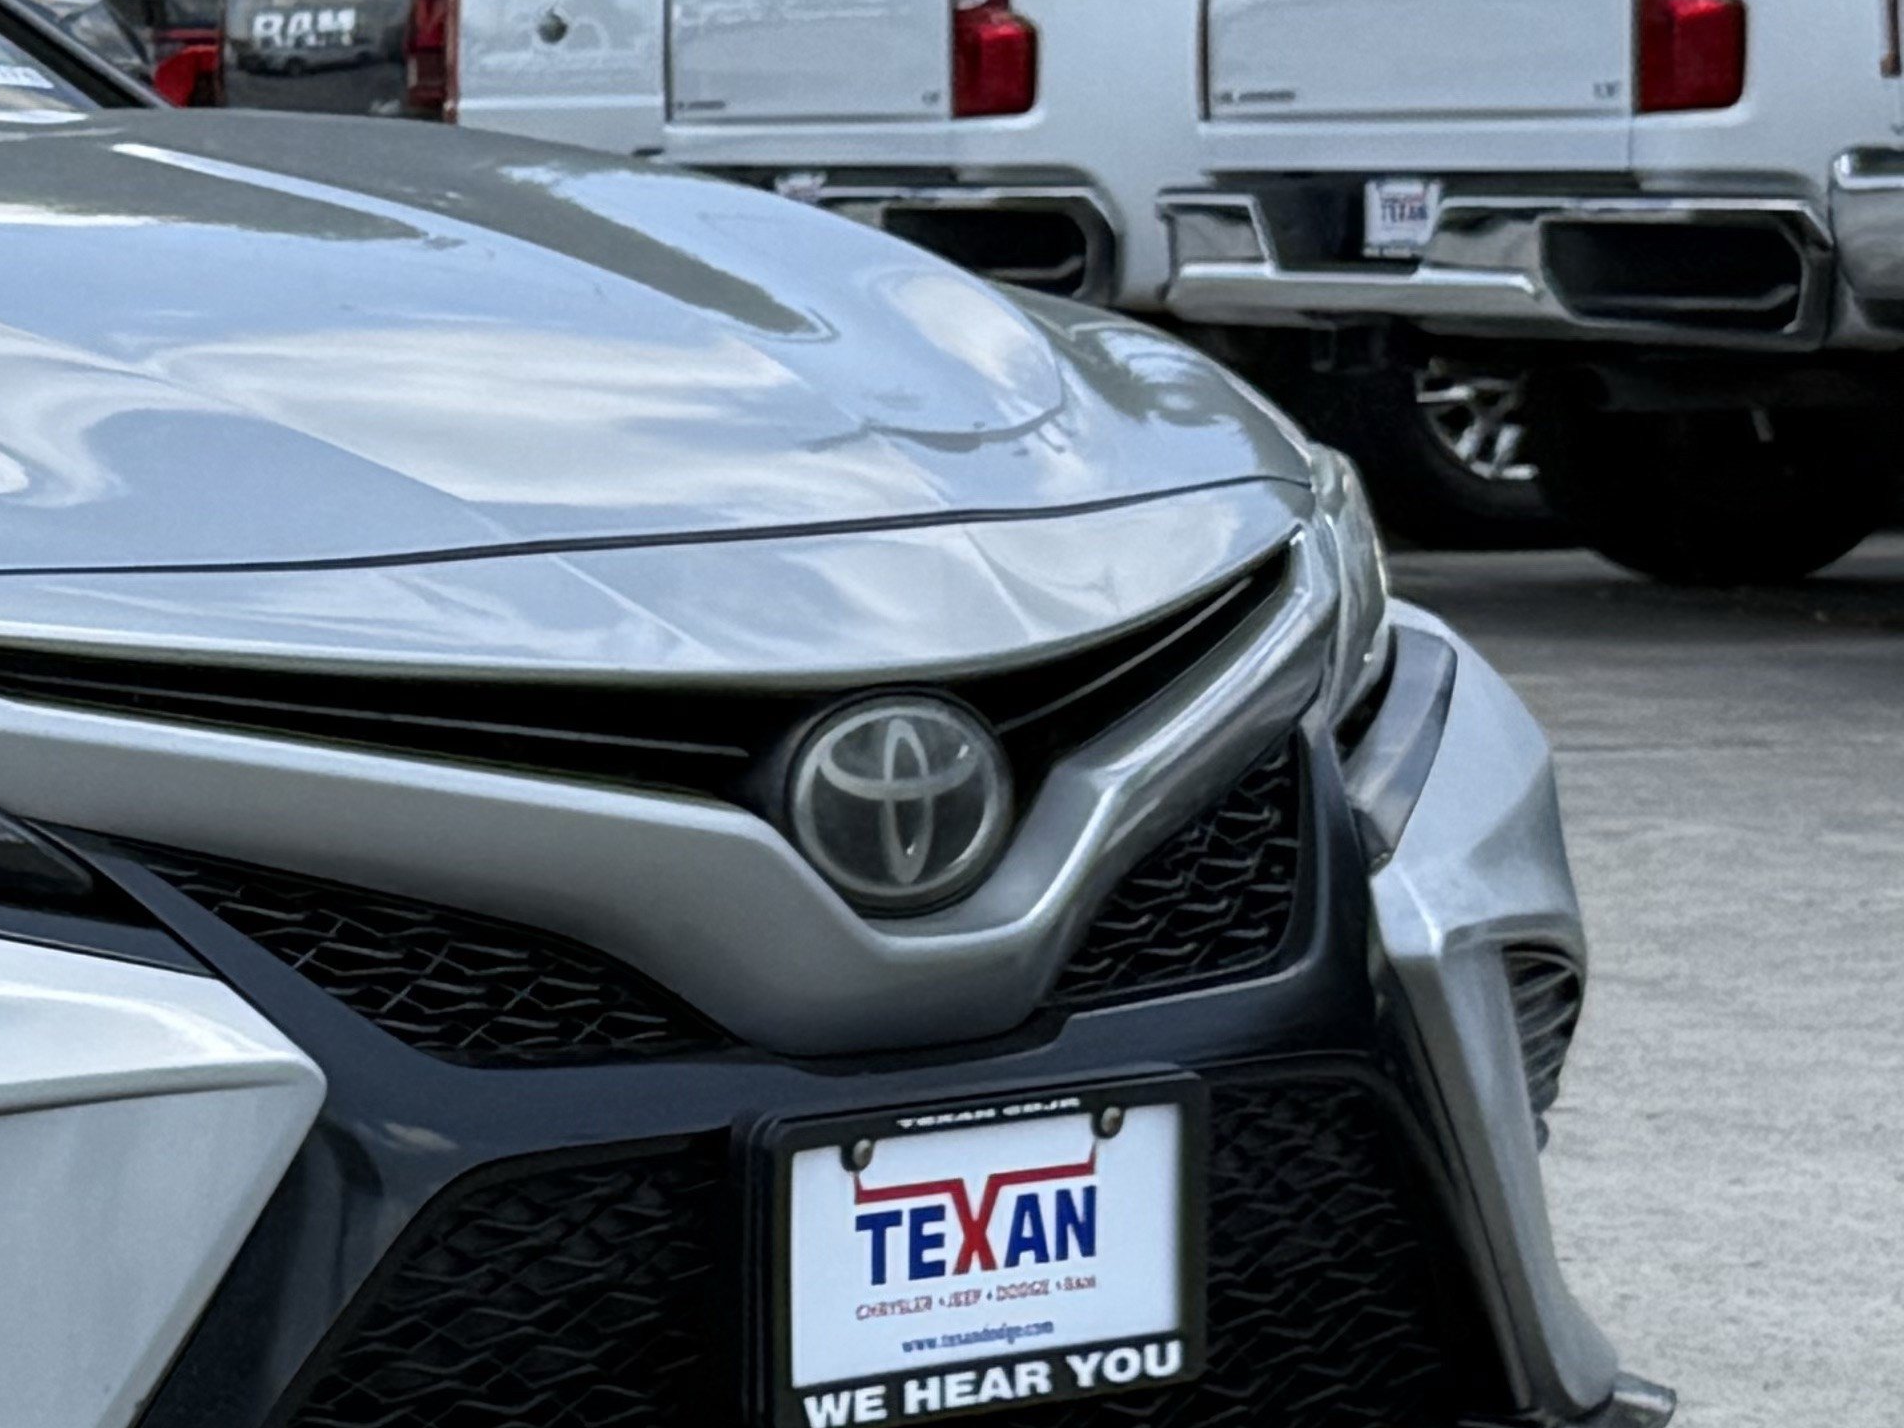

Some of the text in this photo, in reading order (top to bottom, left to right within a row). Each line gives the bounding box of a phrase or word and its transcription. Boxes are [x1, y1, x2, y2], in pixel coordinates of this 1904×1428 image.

[252, 7, 356, 48] RAM
[896, 1108, 996, 1129] TEXAN
[855, 1180, 1097, 1286] TEXAN
[855, 1274, 1096, 1321] CHRYSLER JEEP DODGE RAM
[903, 1361, 1053, 1417] HEAR
[1065, 1339, 1183, 1390] YOU
